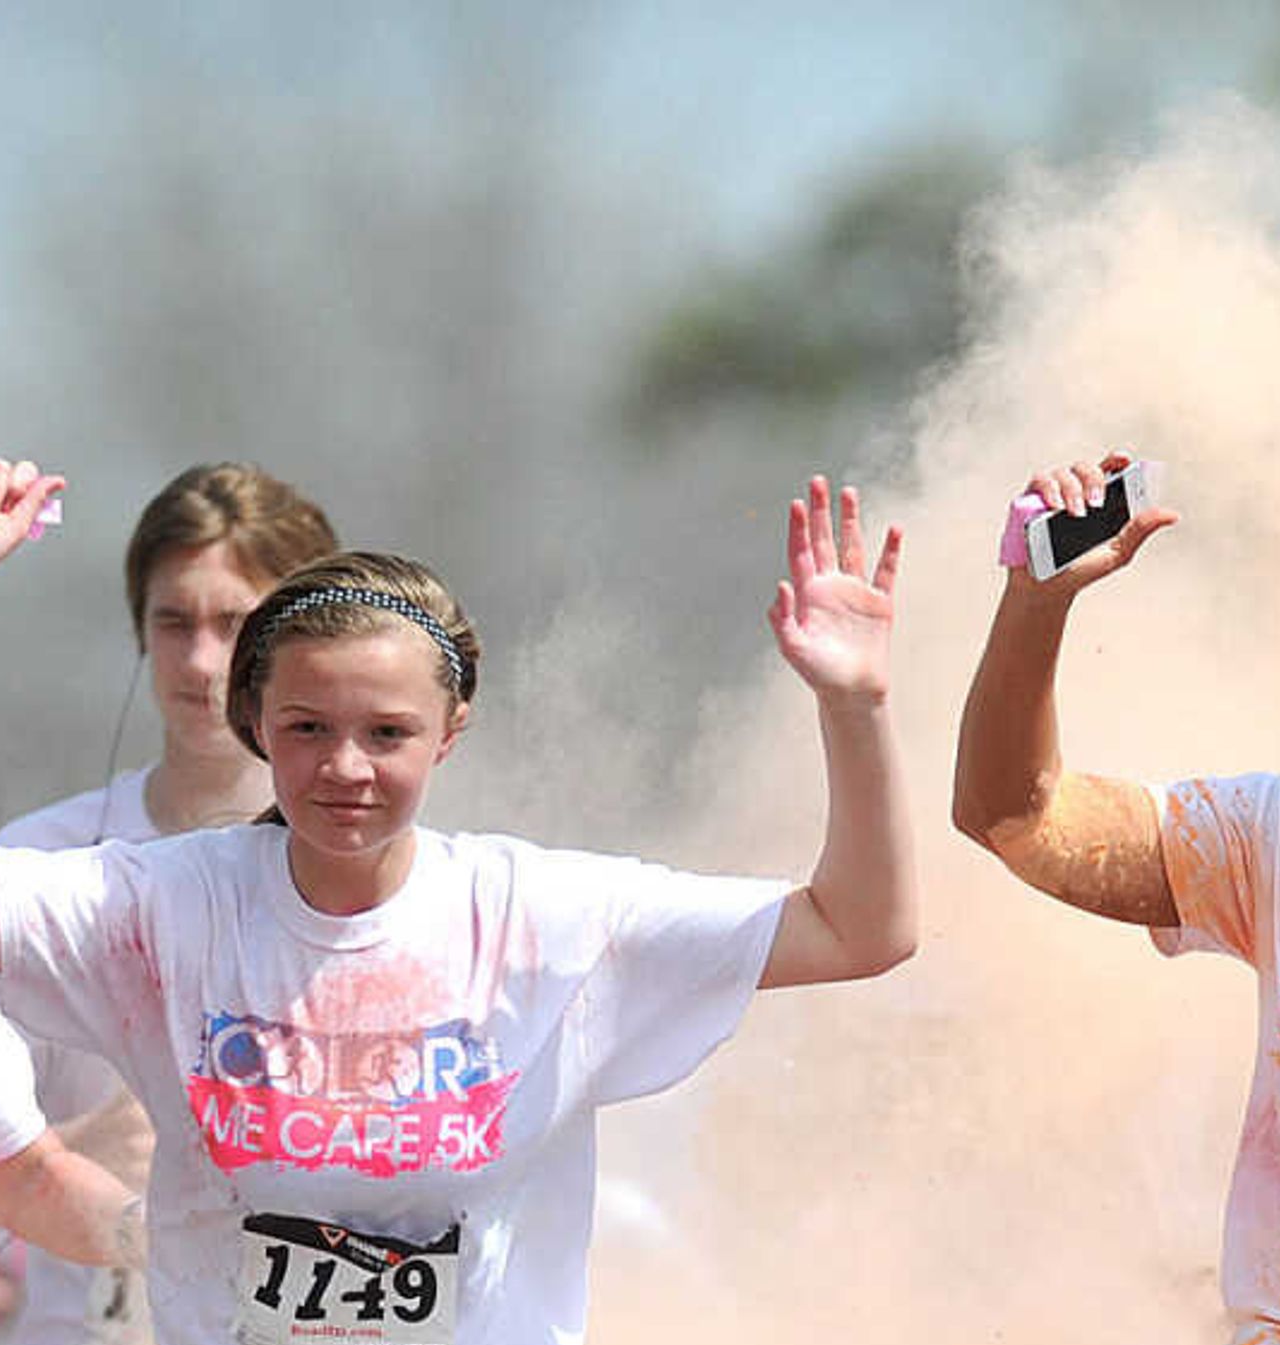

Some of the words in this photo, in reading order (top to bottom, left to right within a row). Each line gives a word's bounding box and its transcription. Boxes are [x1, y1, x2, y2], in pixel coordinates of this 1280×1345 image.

[209, 1022, 468, 1107] COLOR
[201, 1095, 266, 1153] ME
[278, 1110, 421, 1166] CAPE
[436, 1105, 503, 1163] 5K
[253, 1244, 438, 1324] 1149
